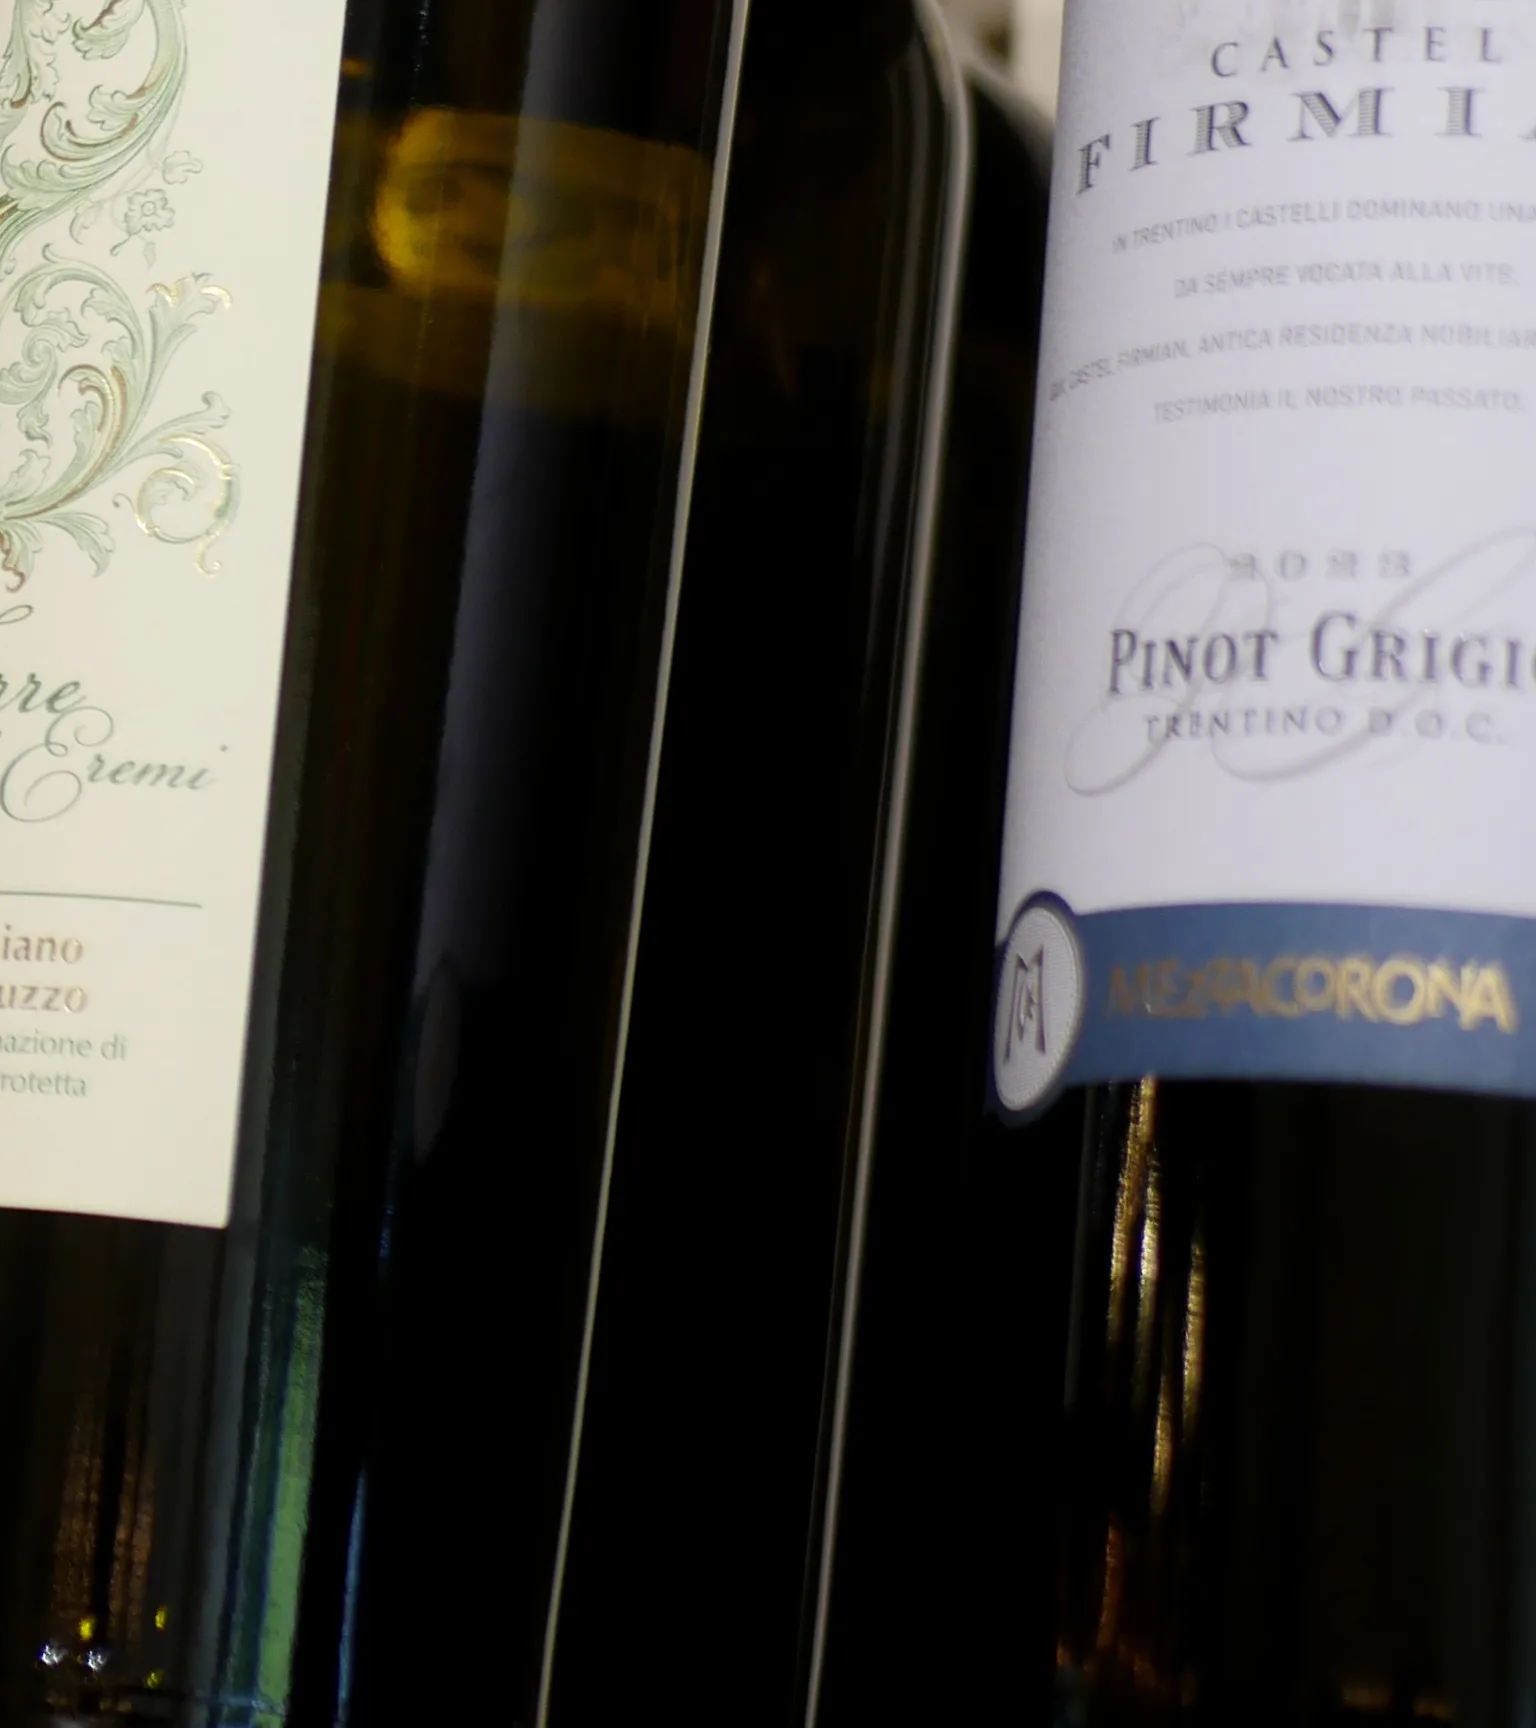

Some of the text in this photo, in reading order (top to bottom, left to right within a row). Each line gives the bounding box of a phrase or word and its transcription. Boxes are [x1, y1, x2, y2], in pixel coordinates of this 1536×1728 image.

[1210, 26, 1502, 78] CASTEL
[1075, 86, 1536, 197] FIRMI
[1108, 608, 1536, 698] PINOT GRIGI
[99, 1032, 129, 1062] di
